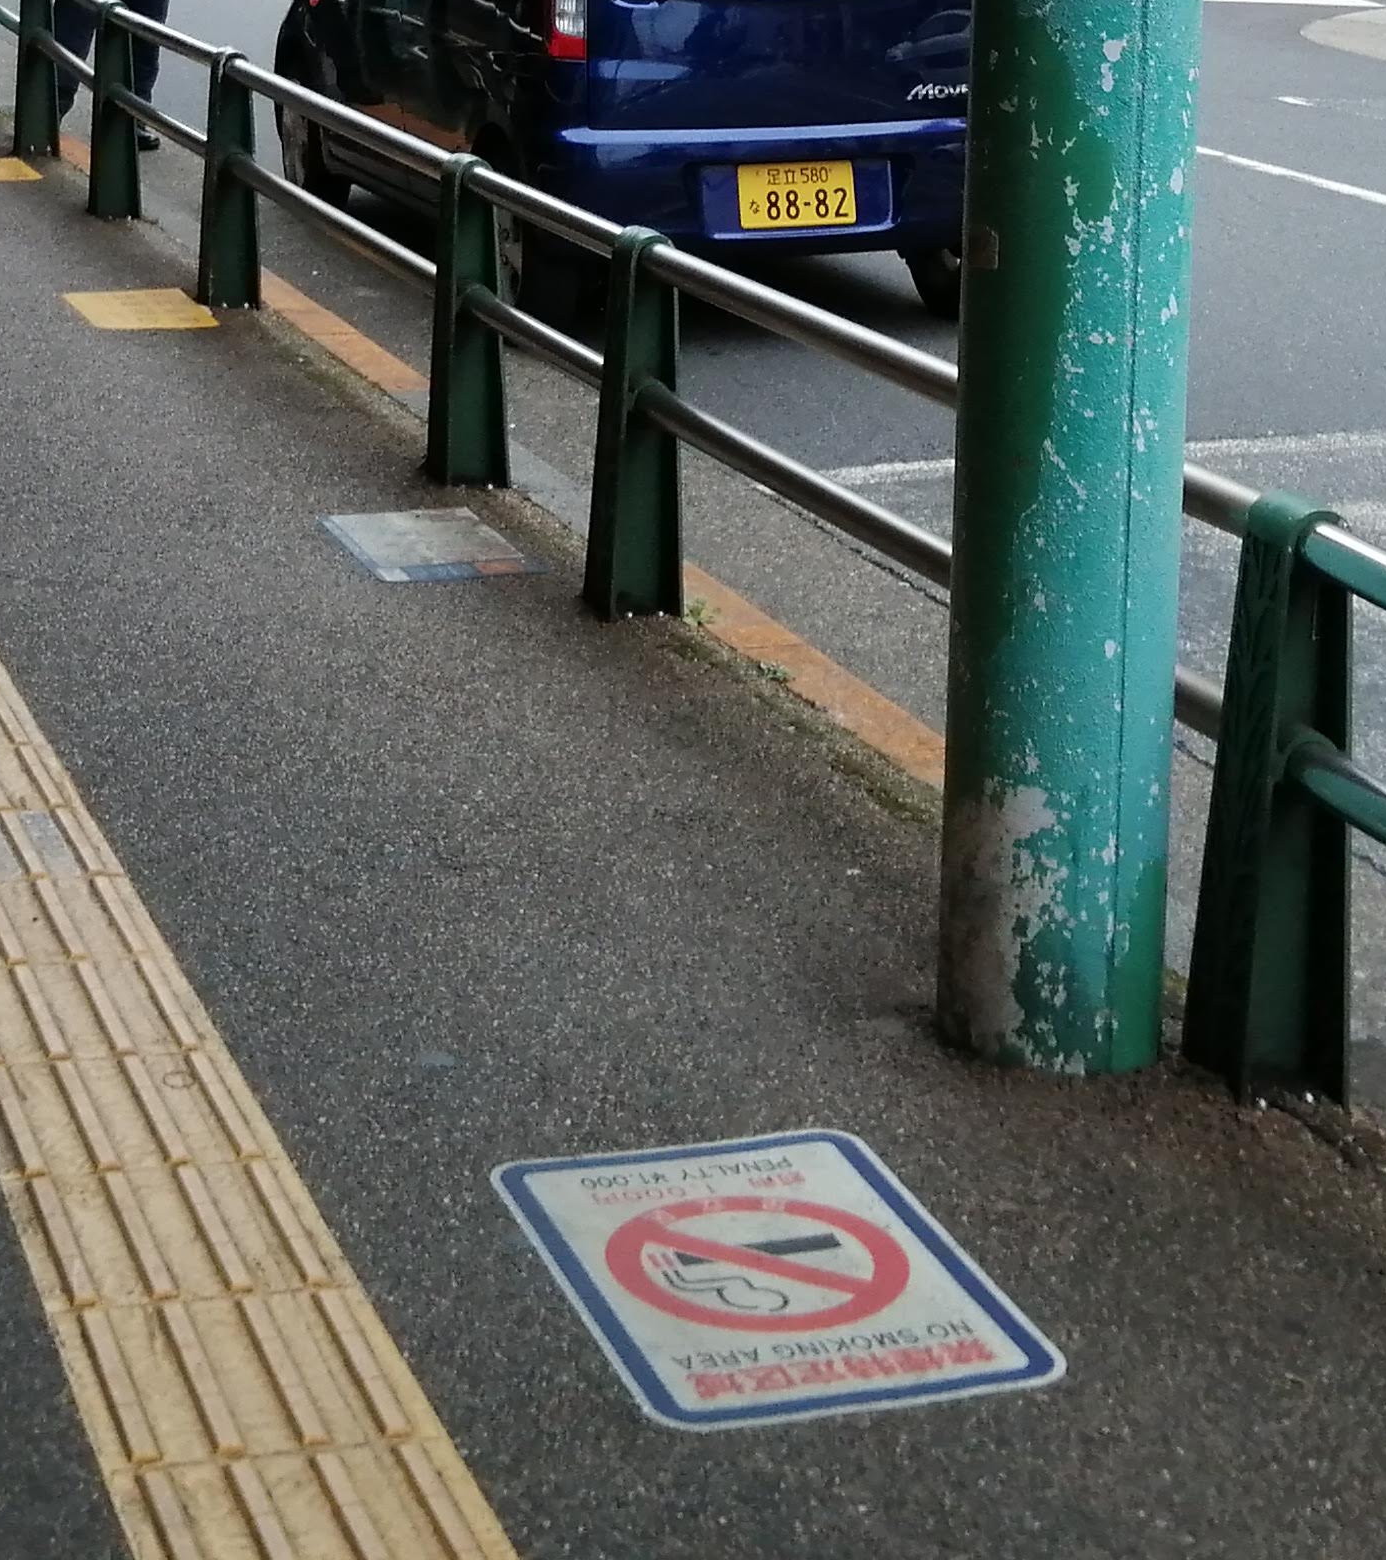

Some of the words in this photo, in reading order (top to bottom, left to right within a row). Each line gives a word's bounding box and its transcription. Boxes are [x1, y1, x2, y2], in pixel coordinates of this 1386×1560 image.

[766, 167, 797, 186] 足立
[800, 165, 830, 186] 580
[765, 187, 850, 221] 88-82
[680, 1153, 795, 1184] PENALTY
[926, 1317, 976, 1339] NO
[668, 1347, 761, 1372] AREA
[771, 1329, 921, 1362] SMOKING
